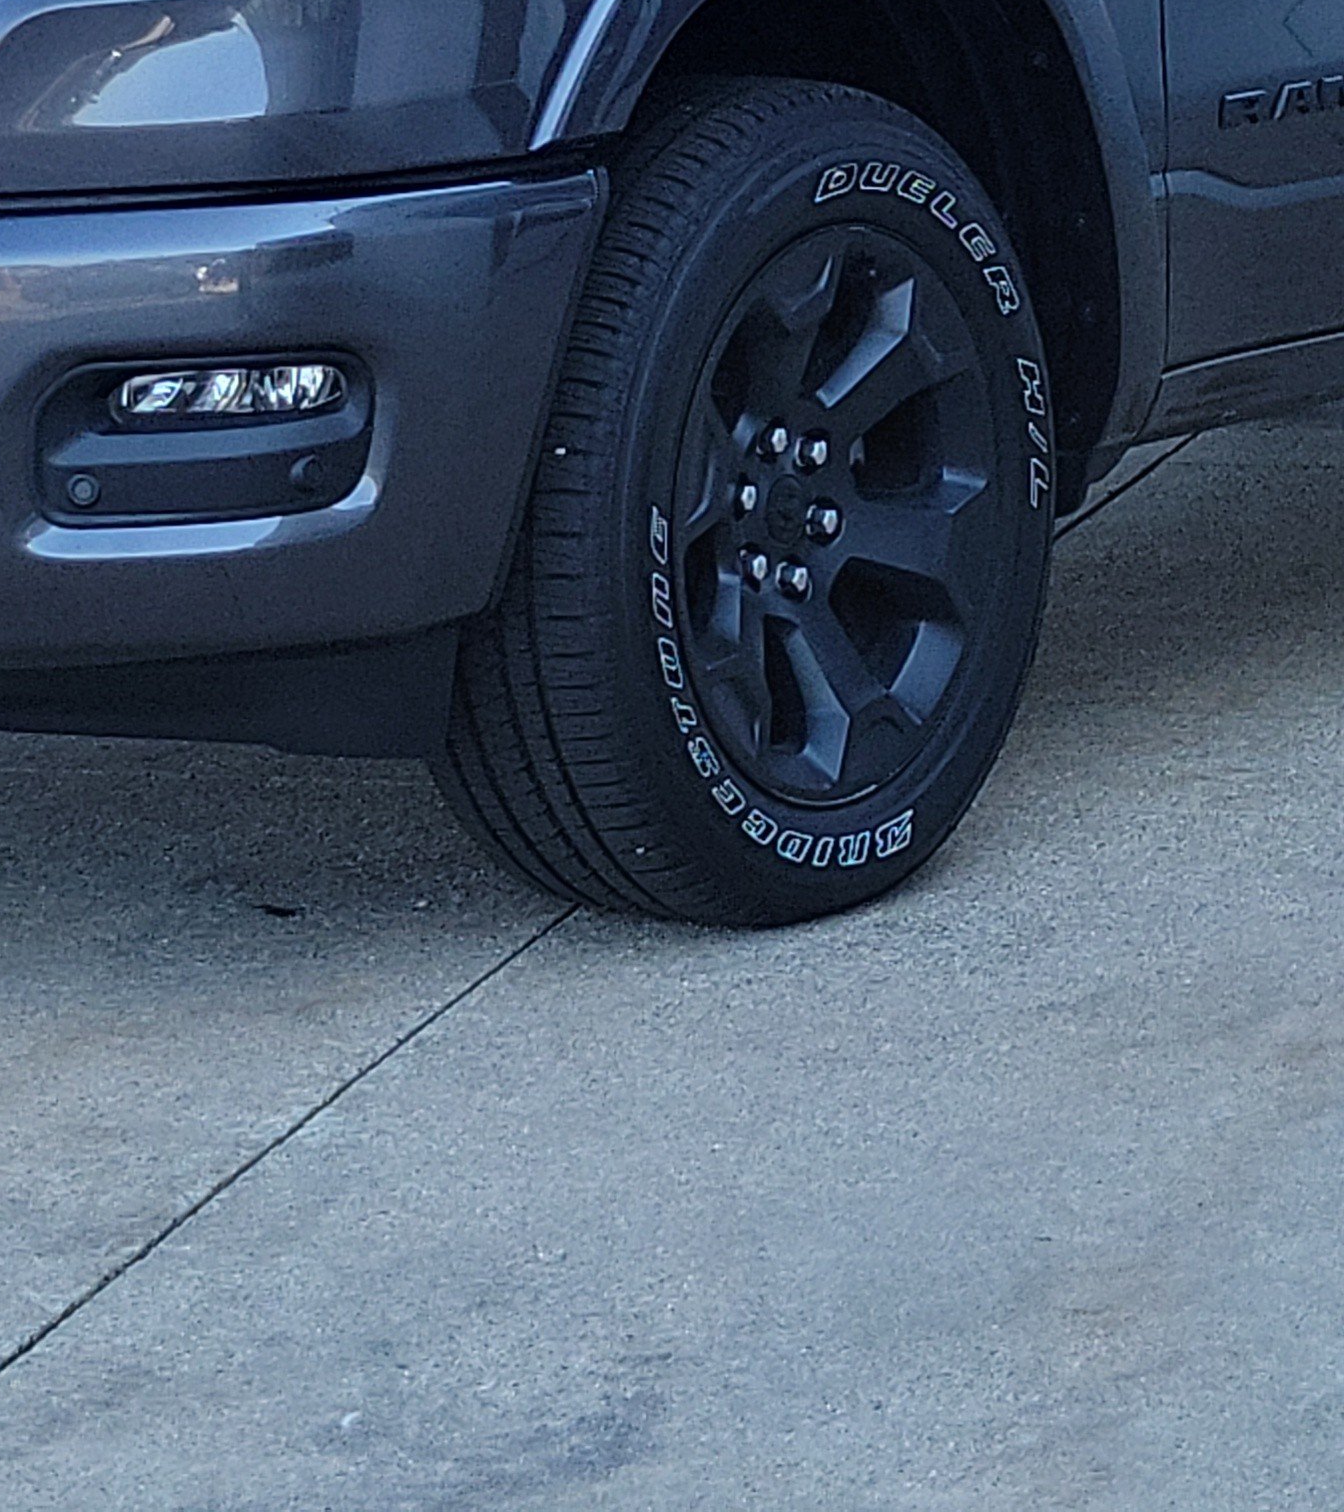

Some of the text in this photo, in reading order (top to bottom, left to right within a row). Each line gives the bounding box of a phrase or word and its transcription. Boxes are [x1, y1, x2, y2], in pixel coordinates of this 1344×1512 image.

[813, 161, 1051, 509] DUELER H/L
[649, 505, 915, 867] BRIDGESTONE
